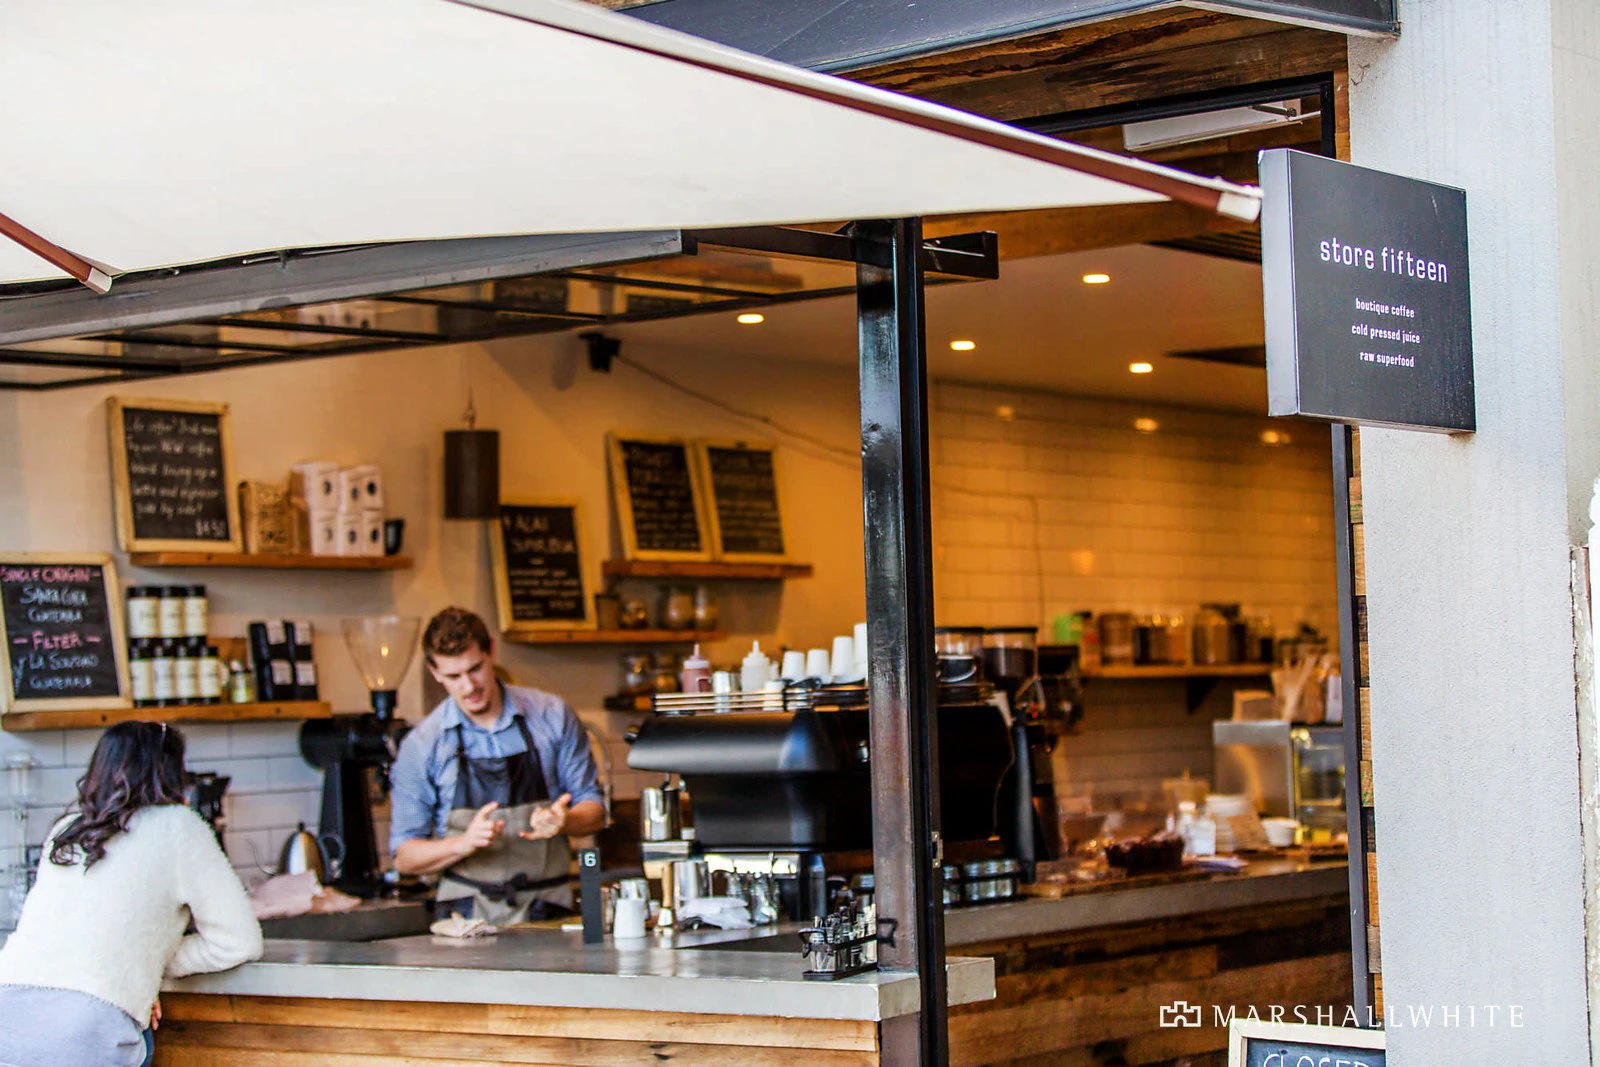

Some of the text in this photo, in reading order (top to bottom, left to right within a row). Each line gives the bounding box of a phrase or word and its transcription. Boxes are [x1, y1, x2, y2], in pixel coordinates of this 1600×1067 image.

[1320, 237, 1448, 283] store fifteen
[1355, 298, 1415, 318] boutique coffee
[1351, 323, 1420, 344] cold pressed juice
[1359, 351, 1415, 368] raw superfood
[584, 851, 596, 867] 6
[1263, 1053, 1370, 1067] CLO
